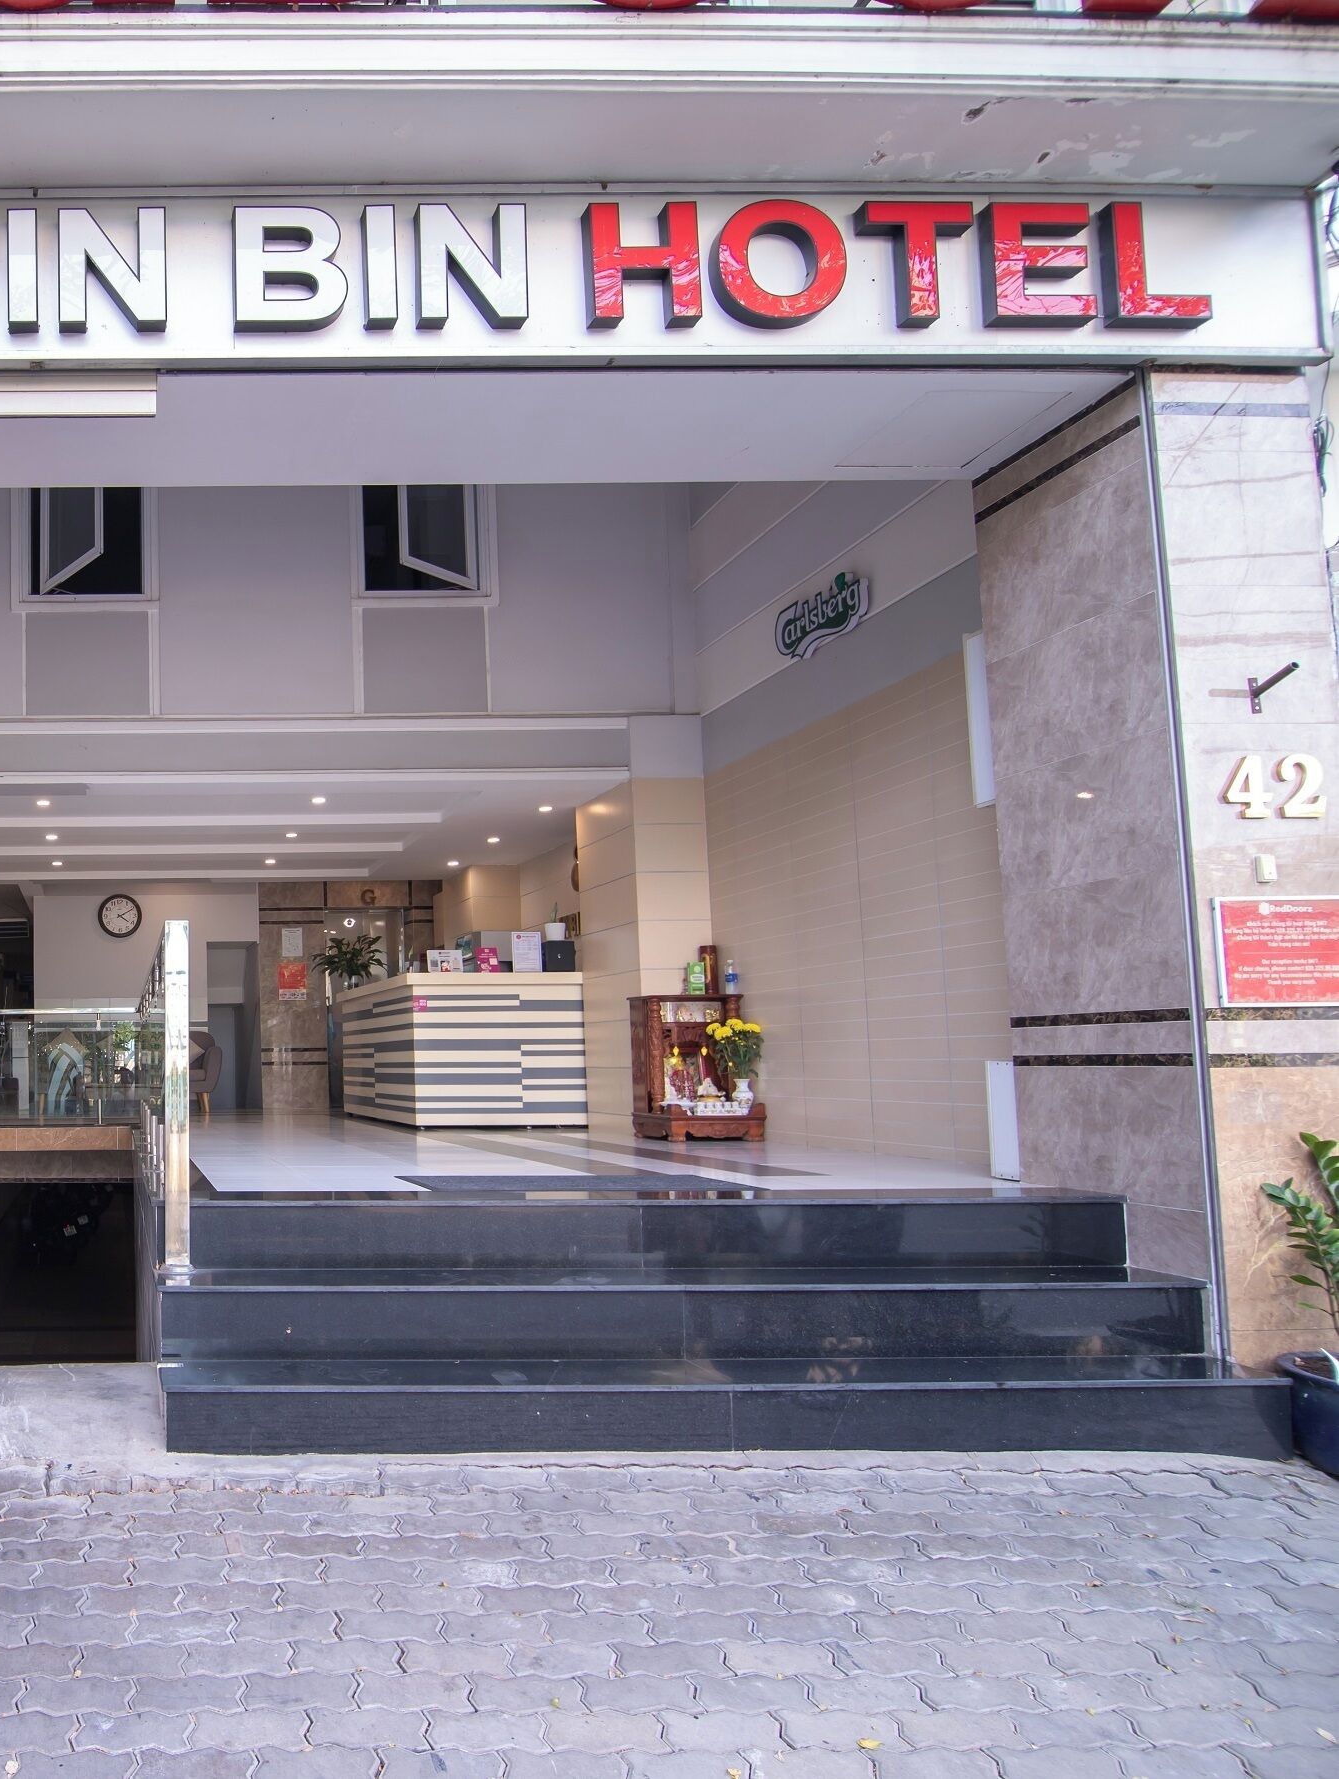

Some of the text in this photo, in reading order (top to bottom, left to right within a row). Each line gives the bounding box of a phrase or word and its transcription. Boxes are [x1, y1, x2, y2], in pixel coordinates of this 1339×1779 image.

[232, 203, 529, 331] BIN
[581, 199, 1213, 329] HOTEL
[775, 578, 860, 657] Carlsberg
[1219, 753, 1327, 819] 42
[361, 889, 377, 906] G
